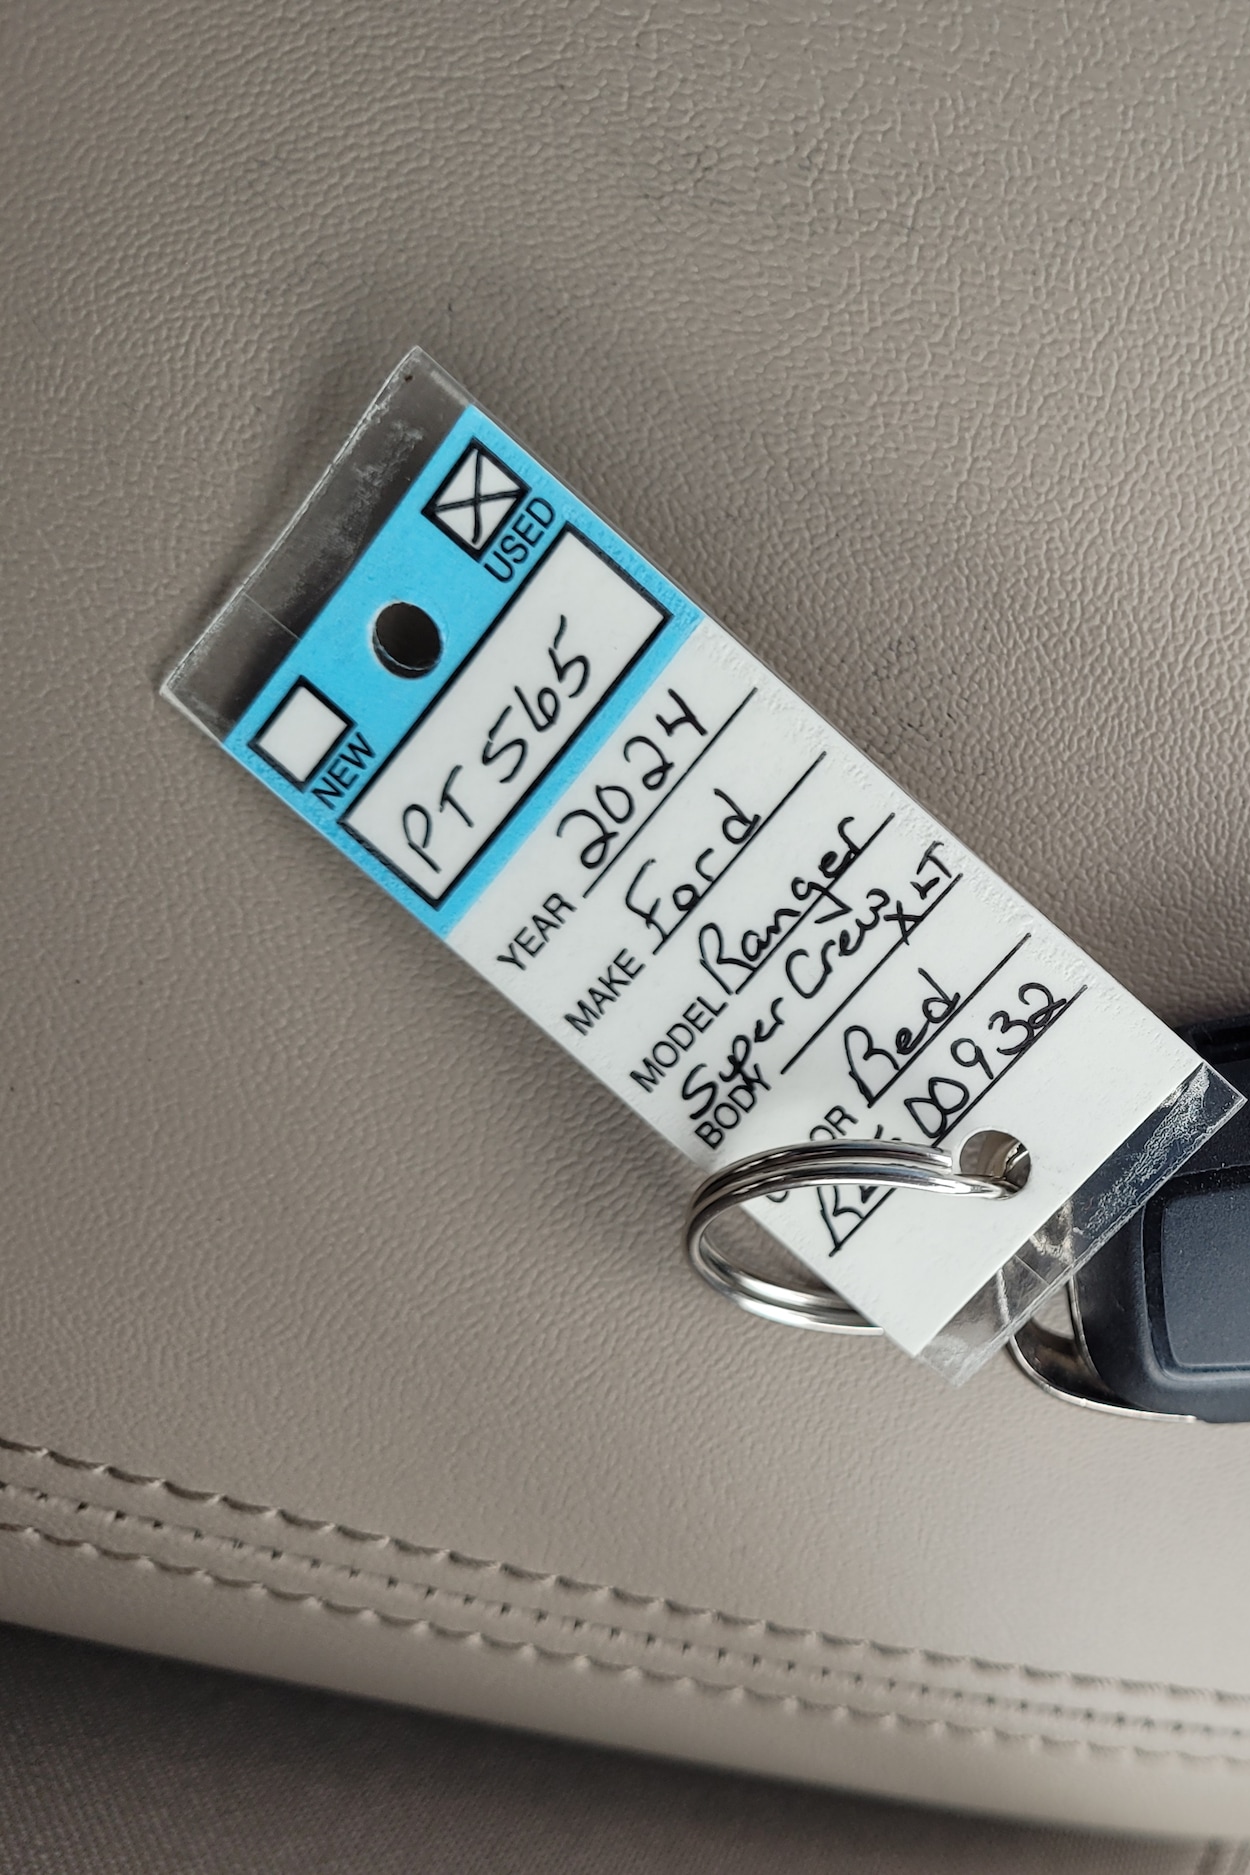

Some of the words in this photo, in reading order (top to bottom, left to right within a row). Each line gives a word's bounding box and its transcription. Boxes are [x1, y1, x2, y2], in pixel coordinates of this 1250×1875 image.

[483, 496, 556, 583] USED
[310, 732, 376, 810] NEW
[556, 688, 708, 870] 2024
[625, 788, 761, 943] Ford
[699, 816, 862, 995] Ranger
[883, 840, 952, 946] XLT
[497, 892, 577, 970] YEAR
[564, 947, 646, 1036] MAKE
[629, 996, 728, 1093] MODEL
[681, 997, 785, 1120] Super
[785, 888, 891, 999] Crew
[843, 967, 961, 1108] Red
[694, 1062, 771, 1150] BODY
[903, 981, 1067, 1139] 00932
